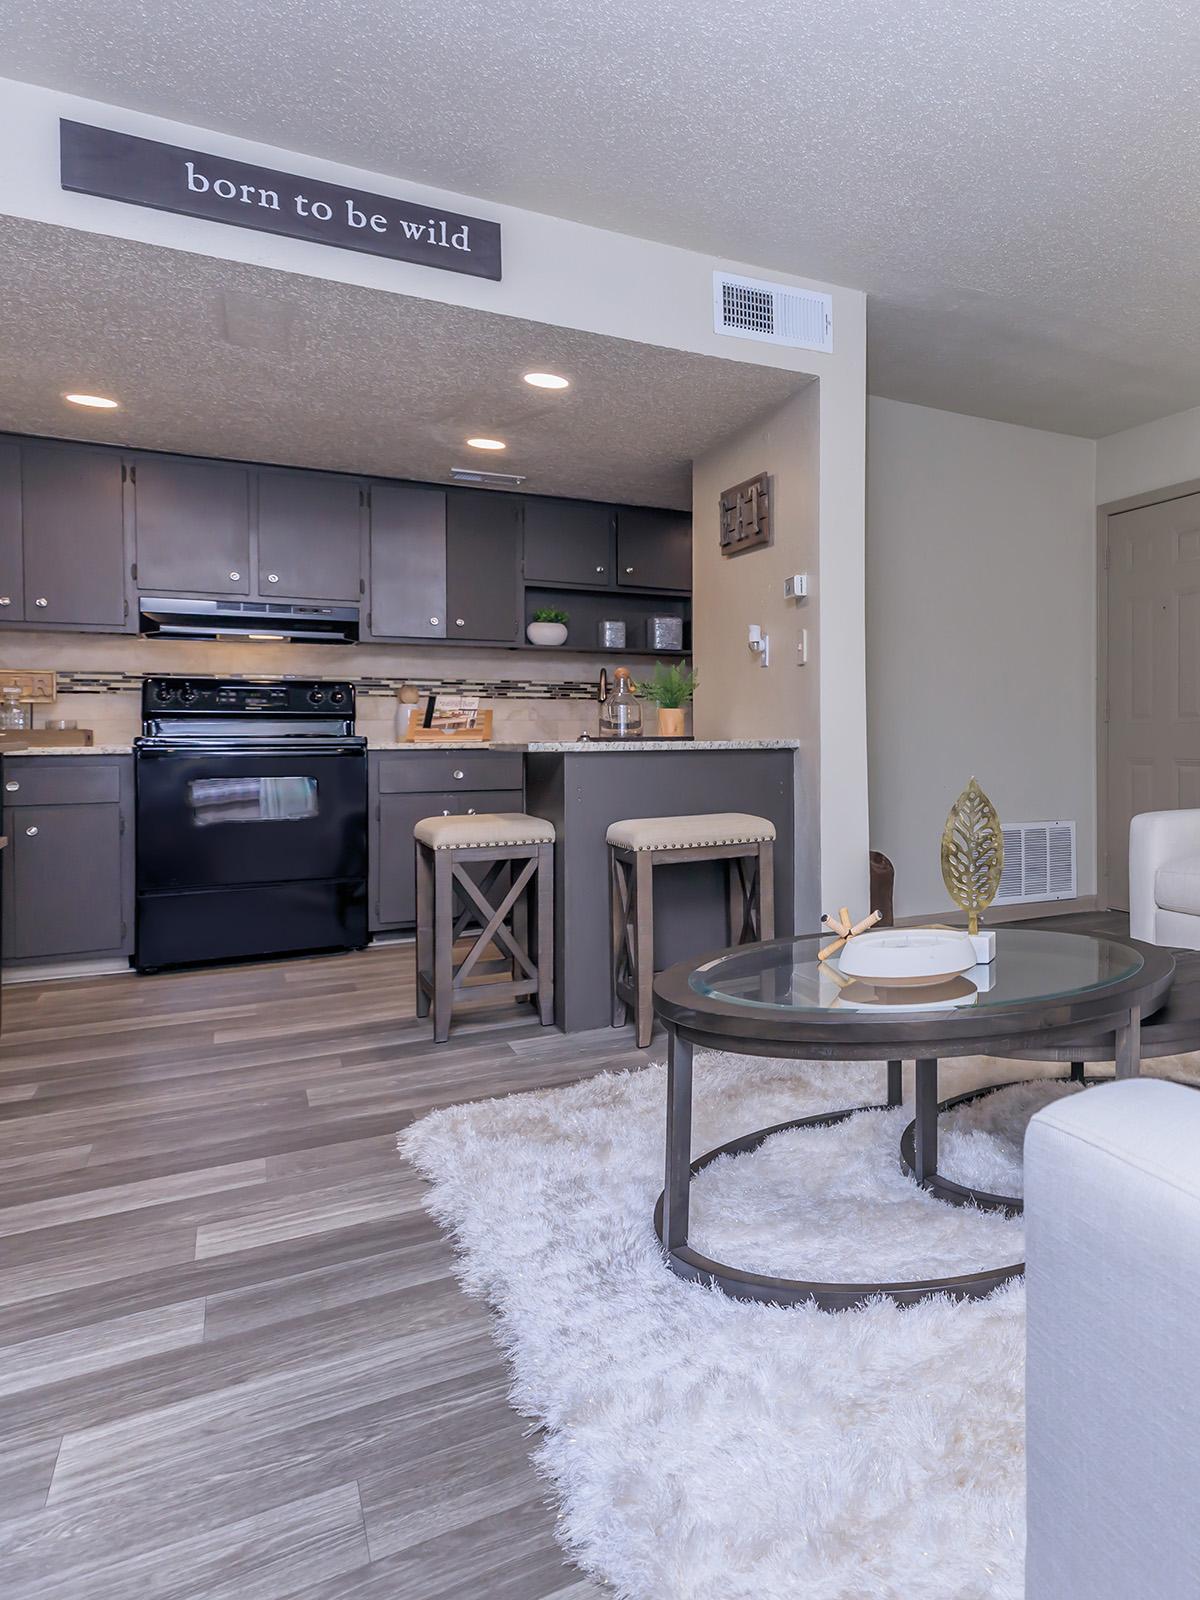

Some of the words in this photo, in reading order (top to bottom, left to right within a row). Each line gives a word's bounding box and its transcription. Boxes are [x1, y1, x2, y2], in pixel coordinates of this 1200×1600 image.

[185, 162, 281, 211] born
[294, 194, 333, 221] to
[346, 200, 388, 233] be
[400, 220, 472, 252] wild
